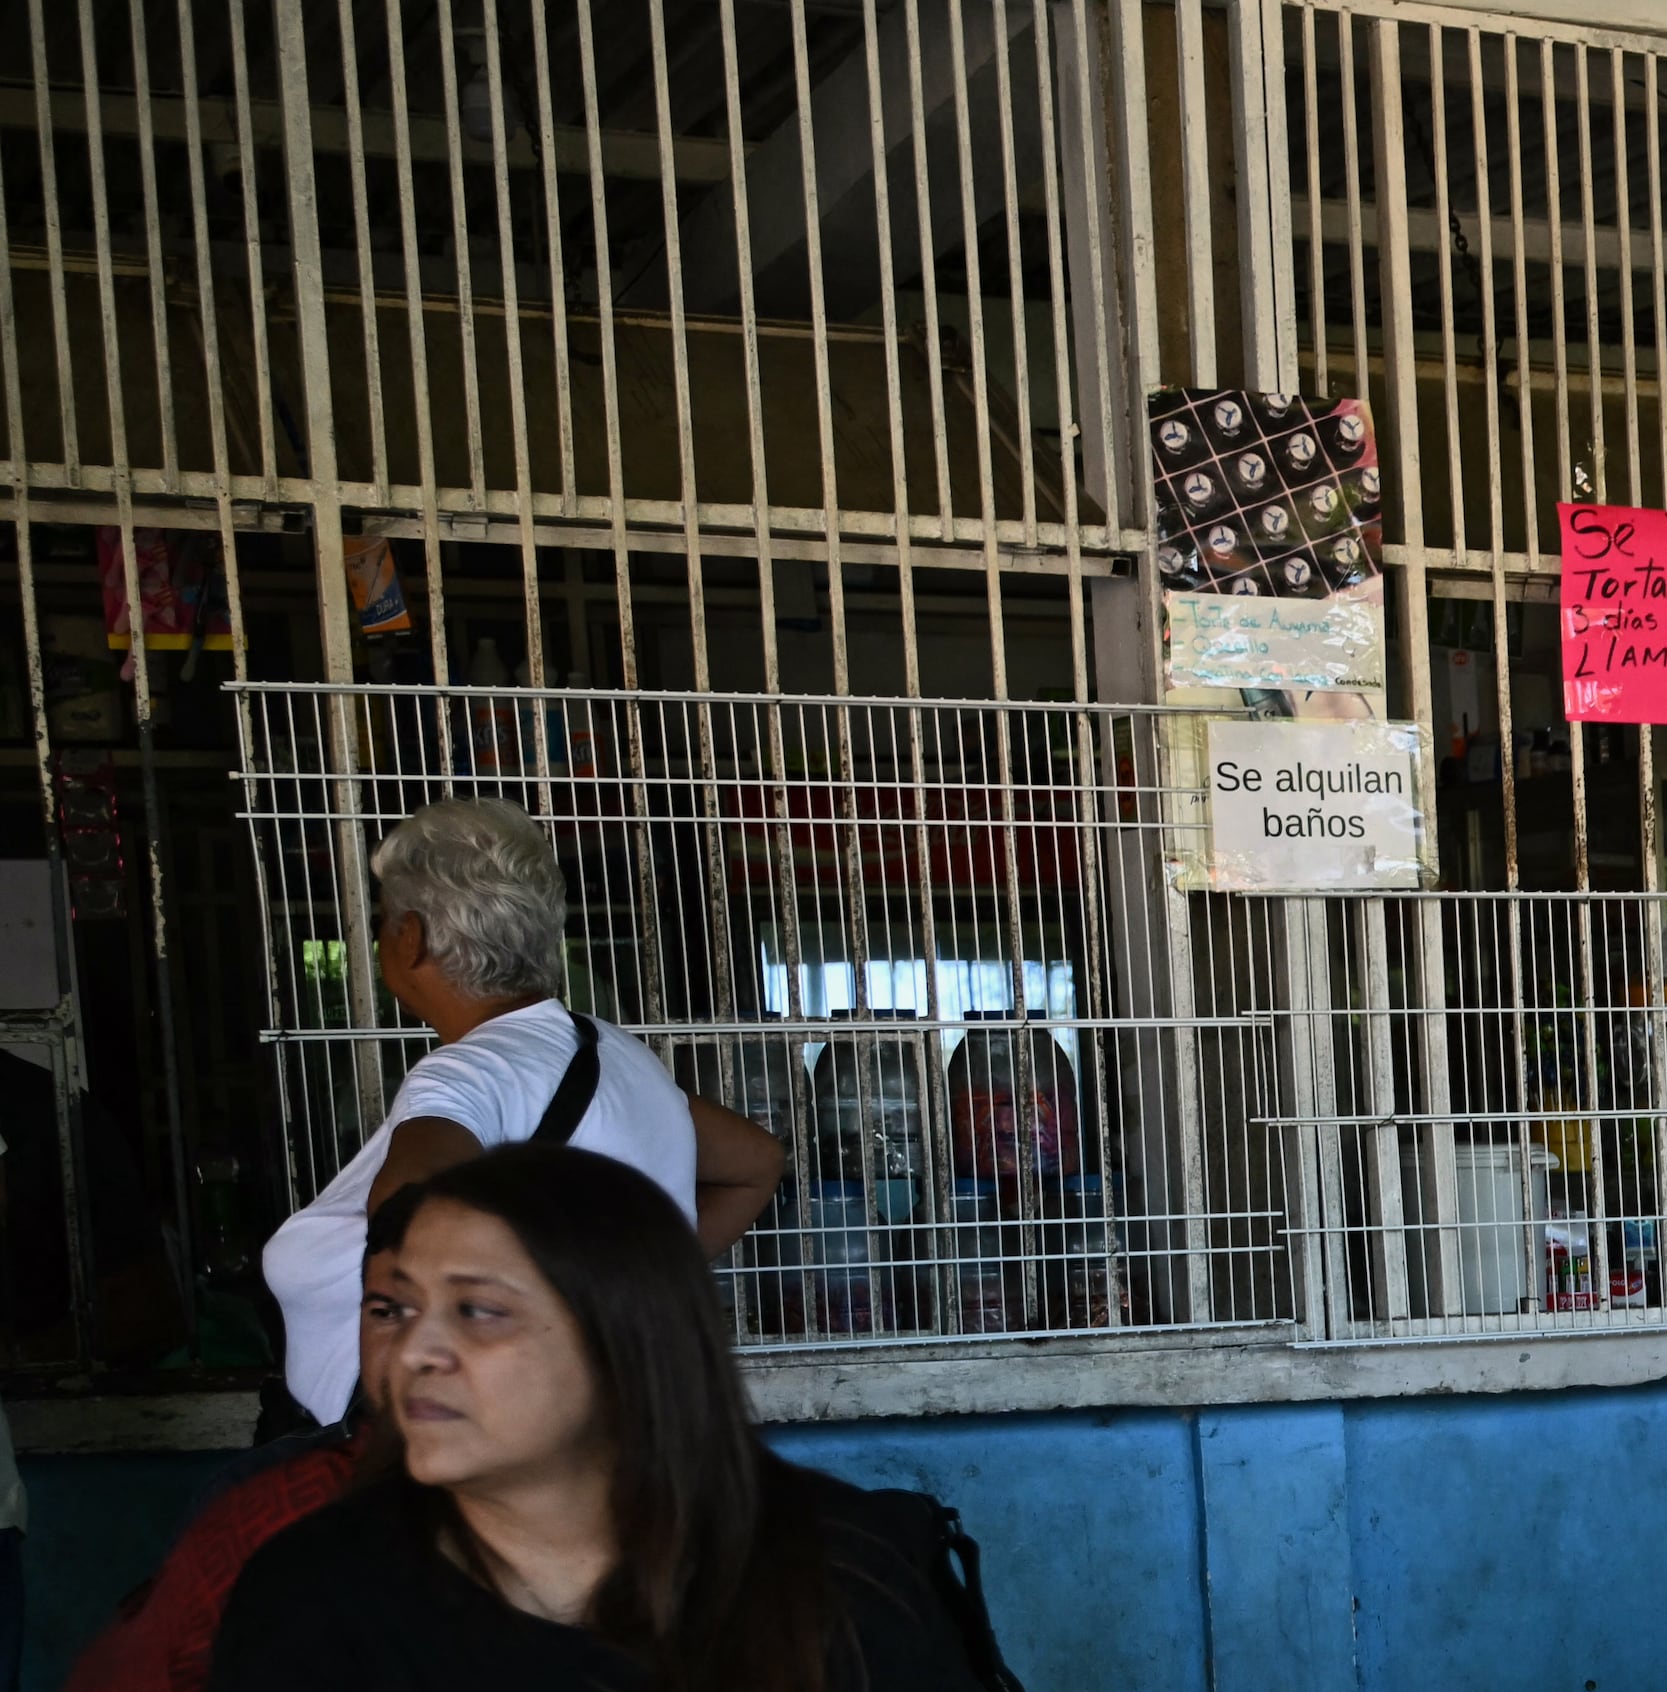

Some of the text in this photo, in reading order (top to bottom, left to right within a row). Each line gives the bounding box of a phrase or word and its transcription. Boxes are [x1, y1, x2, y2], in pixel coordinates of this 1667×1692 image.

[1570, 509, 1635, 559] Se
[1571, 604, 1590, 635] 3
[1216, 761, 1403, 801] Se alquilan
[1263, 806, 1366, 838] baños
